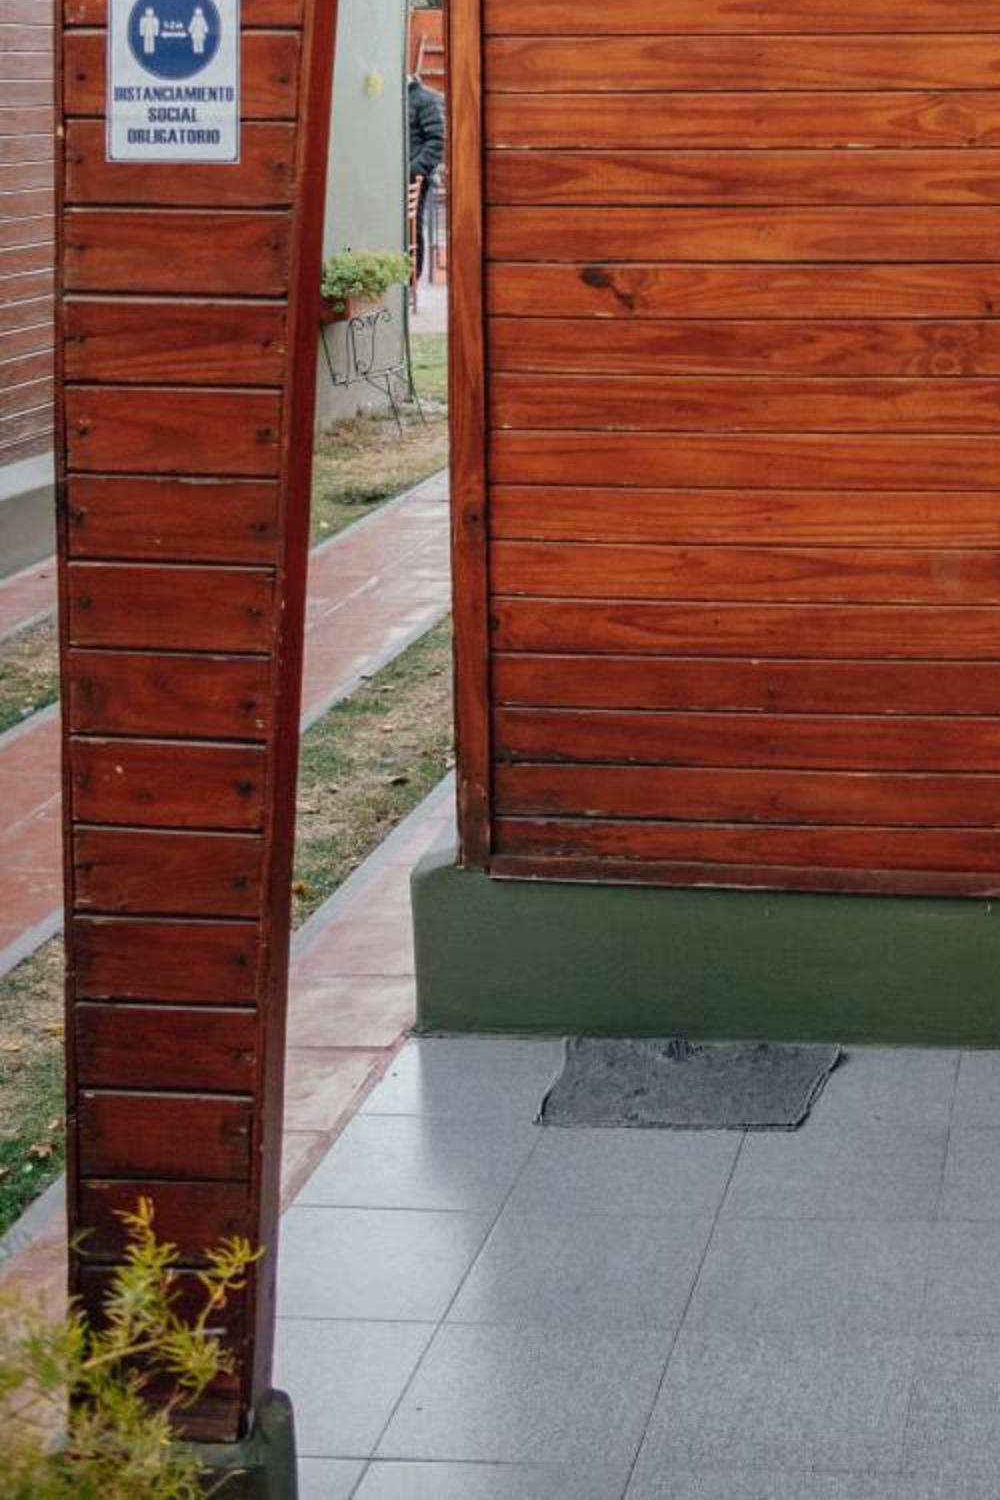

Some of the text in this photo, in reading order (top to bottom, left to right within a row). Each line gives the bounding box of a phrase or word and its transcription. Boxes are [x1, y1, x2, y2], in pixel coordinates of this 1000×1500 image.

[114, 87, 234, 102] DISTANCIAMIENTO
[147, 107, 198, 122] SOCIAL
[127, 129, 220, 145] OBLIGATORIO
